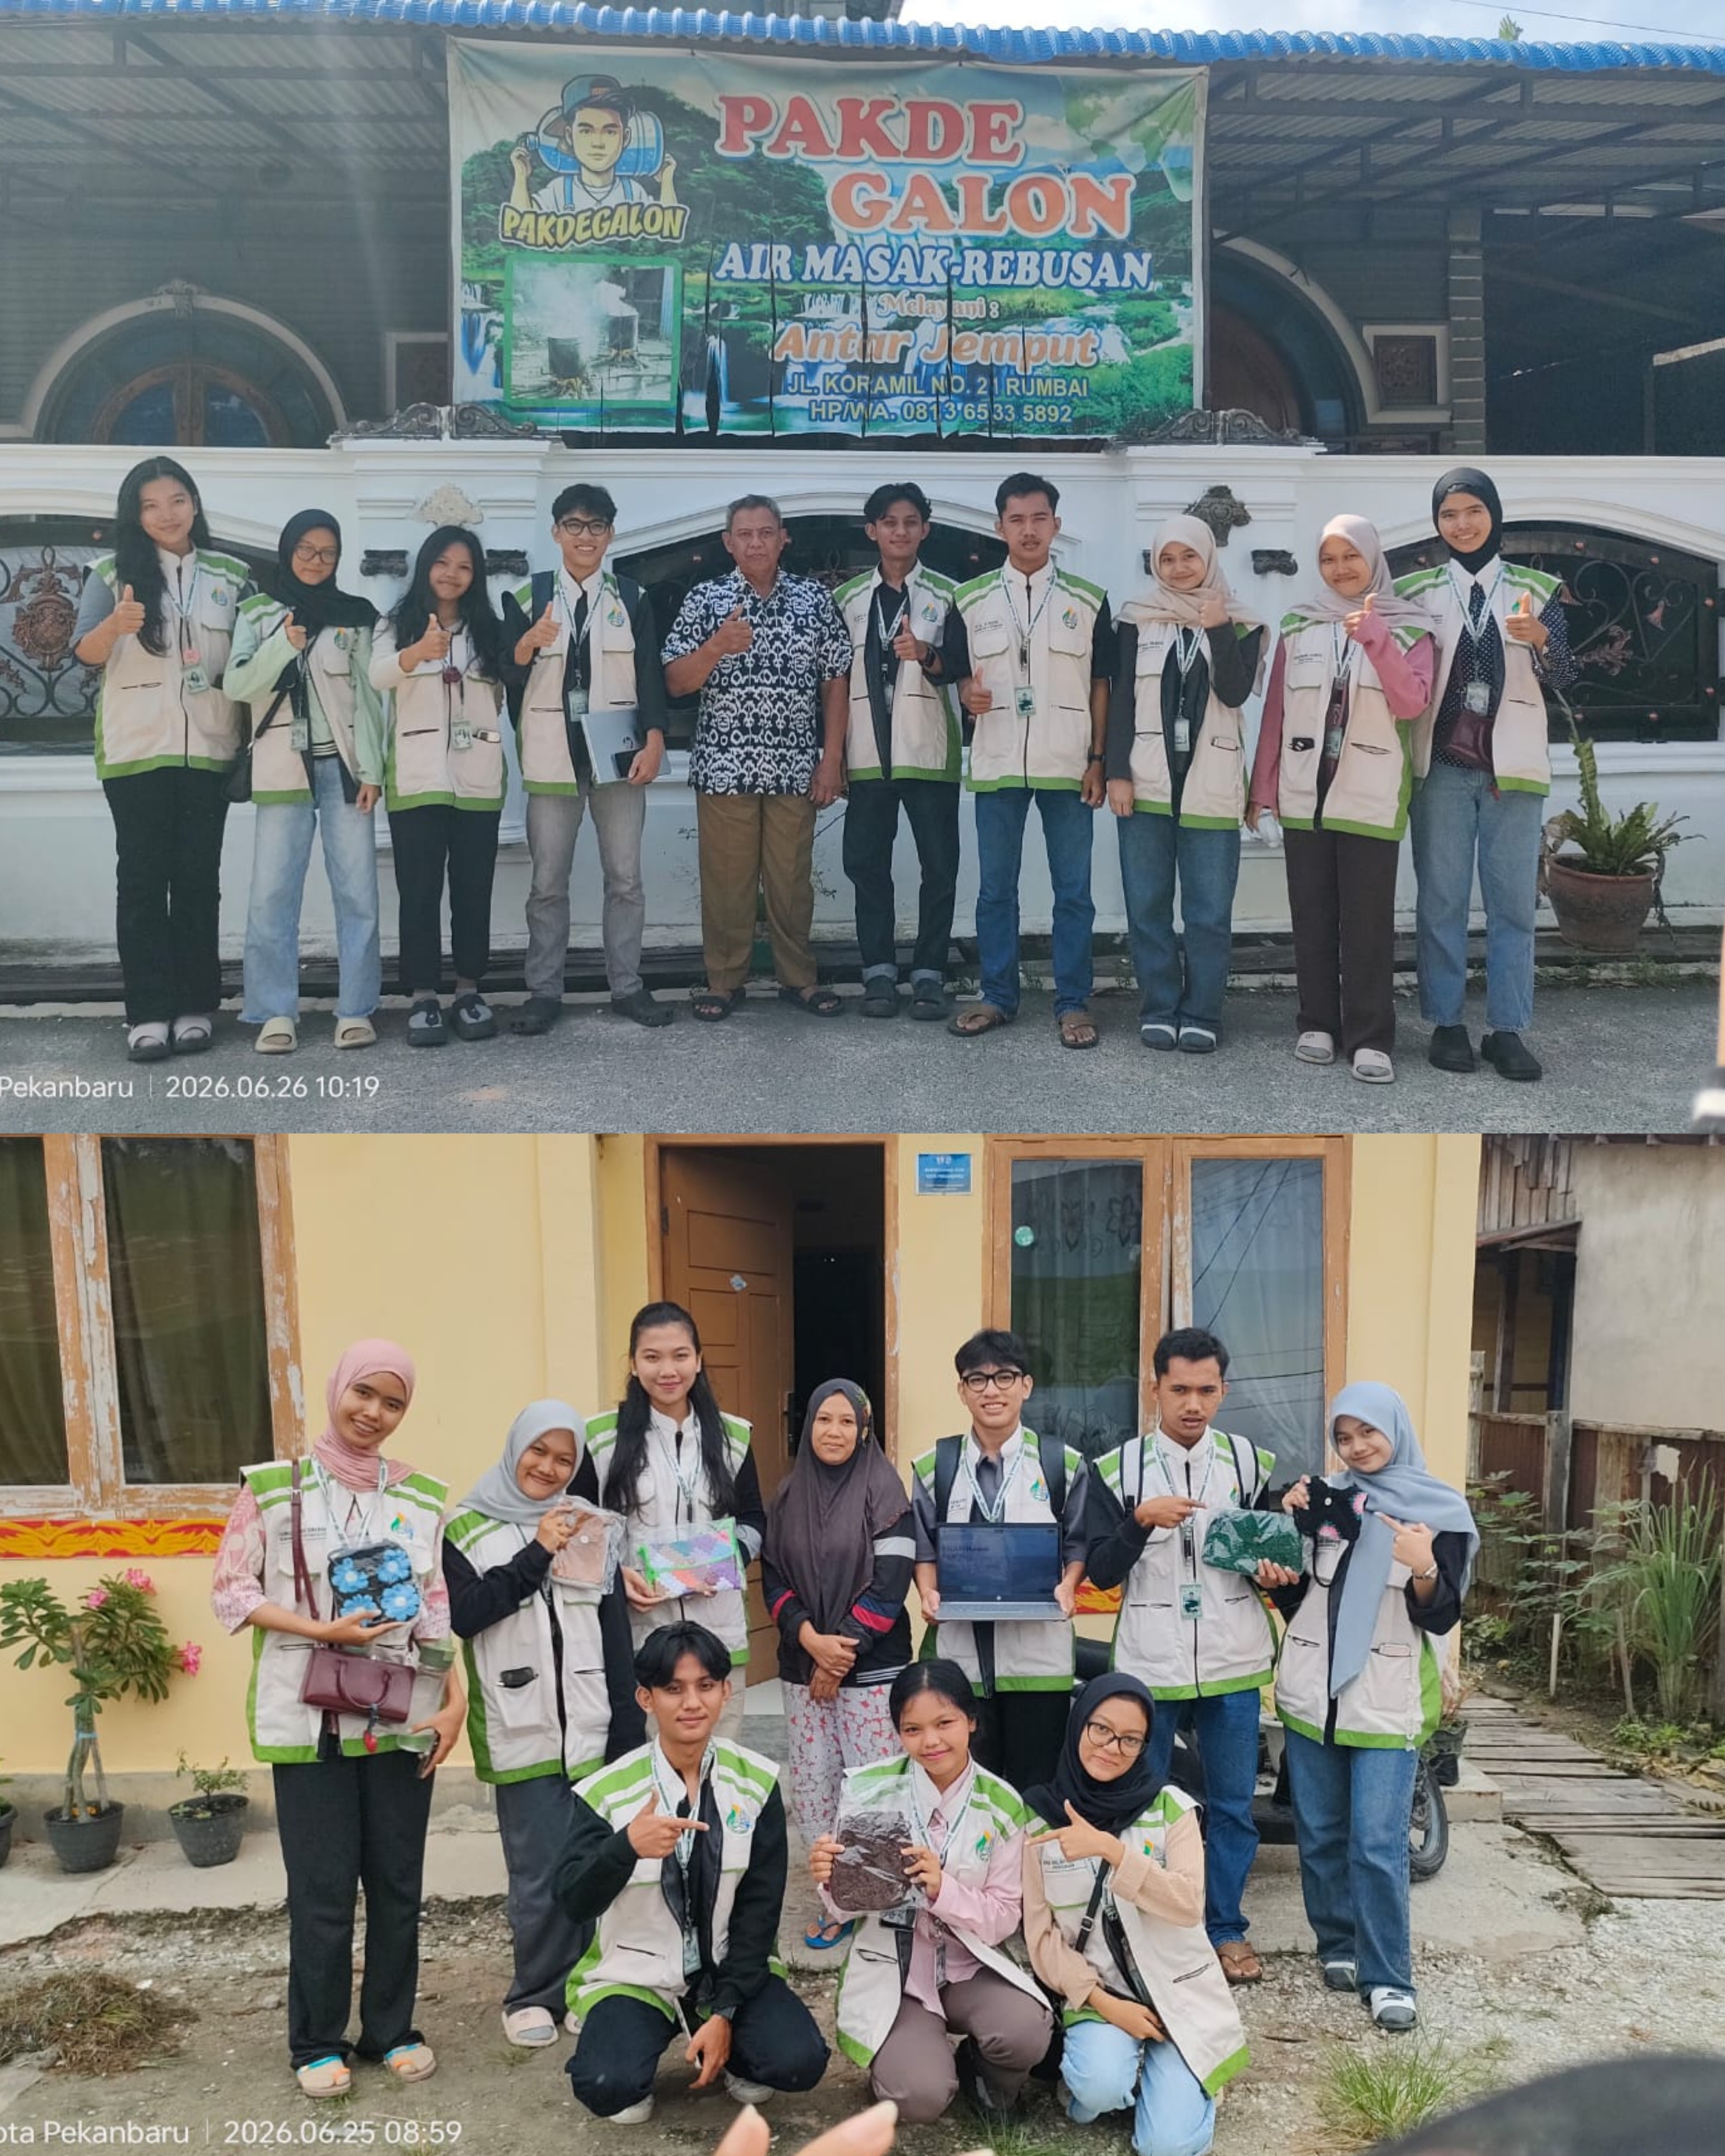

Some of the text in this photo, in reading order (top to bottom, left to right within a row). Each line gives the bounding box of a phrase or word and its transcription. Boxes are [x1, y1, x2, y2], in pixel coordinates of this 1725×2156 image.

[718, 94, 1022, 163] PAKDE
[501, 203, 685, 248] PAKDEGALON
[831, 171, 1134, 236] GALON
[715, 242, 1152, 288] AIR MASAK-REBUSAN
[878, 291, 986, 320] Melayani
[774, 323, 1099, 374] Antar Jemput
[788, 375, 818, 393] JL.
[825, 374, 925, 394] KORAMIL
[931, 375, 970, 394] NO.
[1006, 378, 1088, 397] RUMBAI
[811, 401, 1072, 423] HP/WA. 0813 6533 5892
